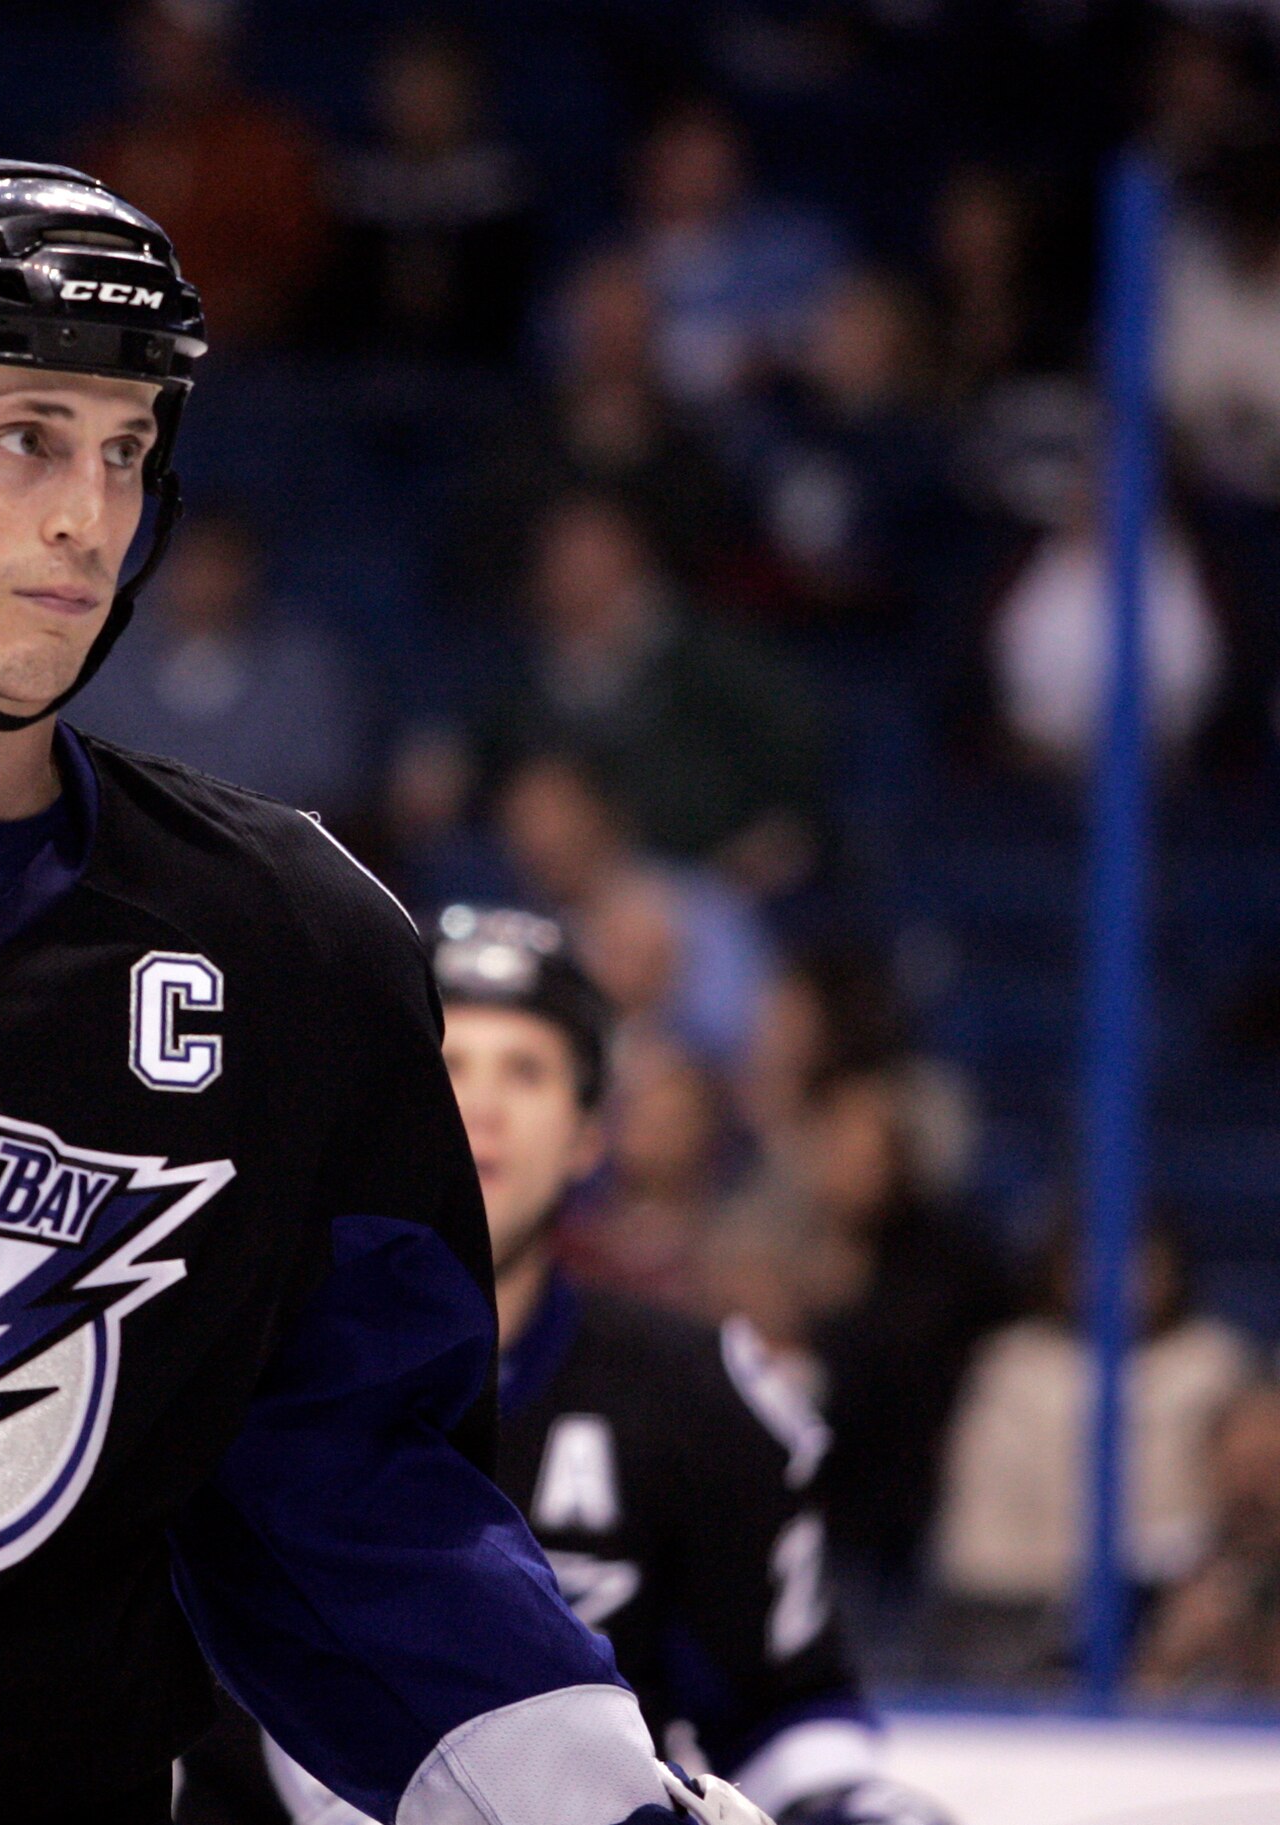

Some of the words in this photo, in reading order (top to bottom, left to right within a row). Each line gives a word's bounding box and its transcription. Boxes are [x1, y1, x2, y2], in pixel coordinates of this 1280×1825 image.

[60, 279, 165, 310] CCM
[129, 950, 224, 1093] C
[530, 1412, 622, 1535] A
